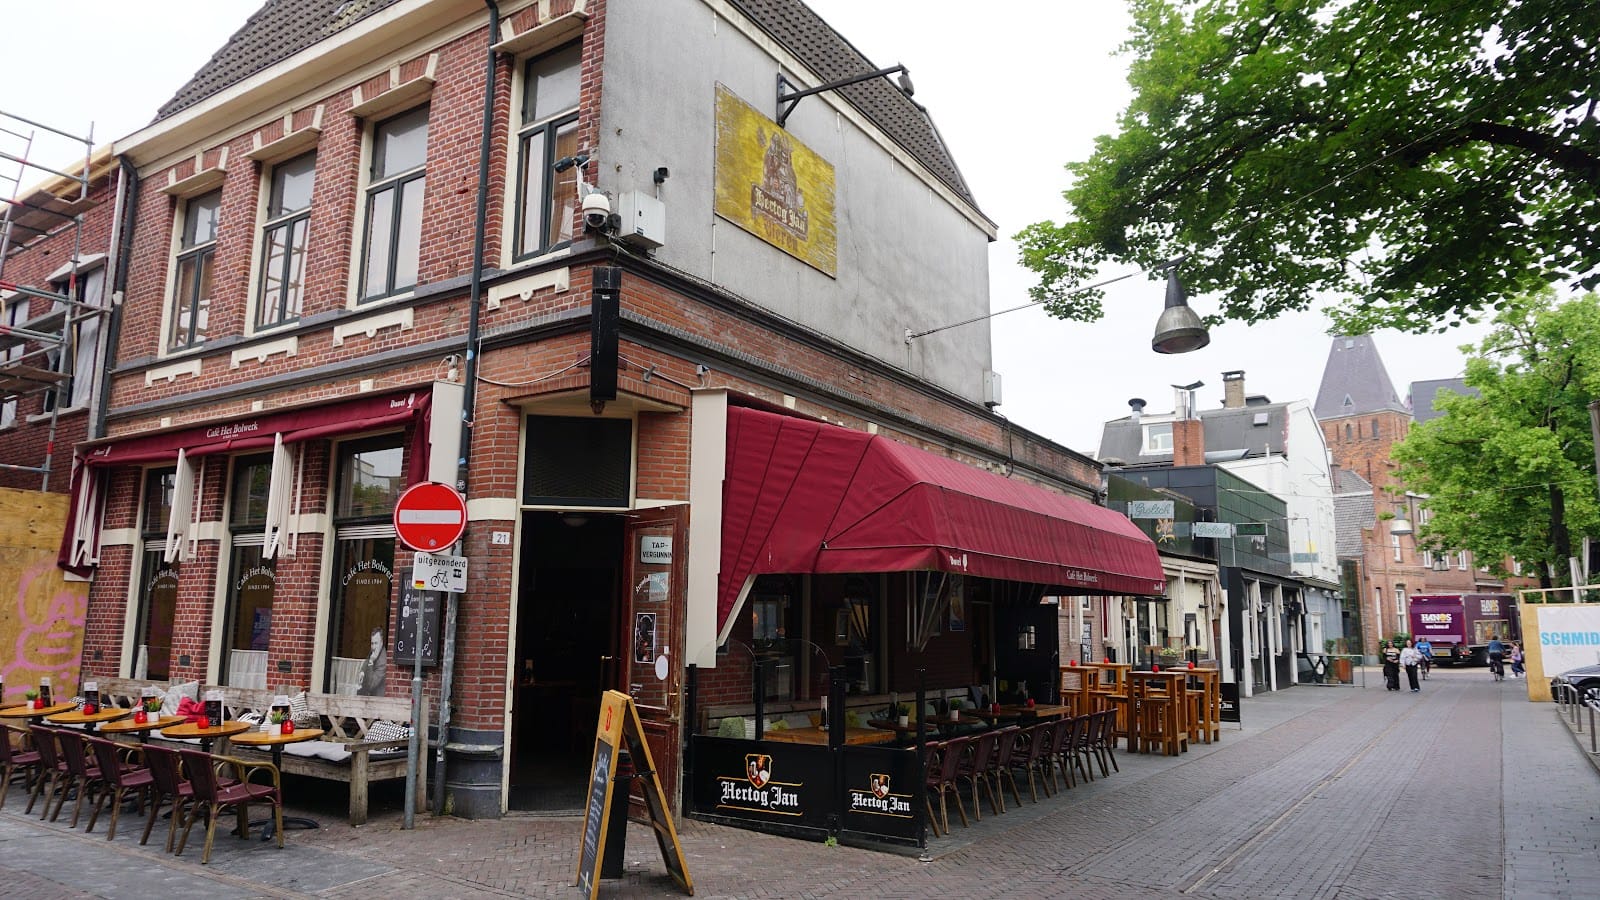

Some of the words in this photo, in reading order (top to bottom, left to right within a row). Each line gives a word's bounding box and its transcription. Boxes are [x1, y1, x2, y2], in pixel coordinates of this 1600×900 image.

[755, 187, 787, 223] Hertog
[206, 428, 220, 438] Café
[220, 425, 232, 436] Het
[233, 421, 258, 434] Bolwerk
[496, 534, 507, 544] 21
[418, 556, 466, 568] uitgezonderd
[236, 572, 249, 590] Café
[249, 567, 260, 577] Het
[342, 565, 357, 586] Café
[358, 560, 370, 572] Het
[371, 559, 394, 583] Bolwer
[1066, 570, 1076, 580] Café
[1421, 614, 1452, 622] HANOS
[1541, 632, 1600, 646] SCHMID
[720, 780, 769, 807] Hertog
[770, 786, 799, 810] Jan
[851, 792, 888, 812] Hertog
[888, 796, 910, 814] Jan
